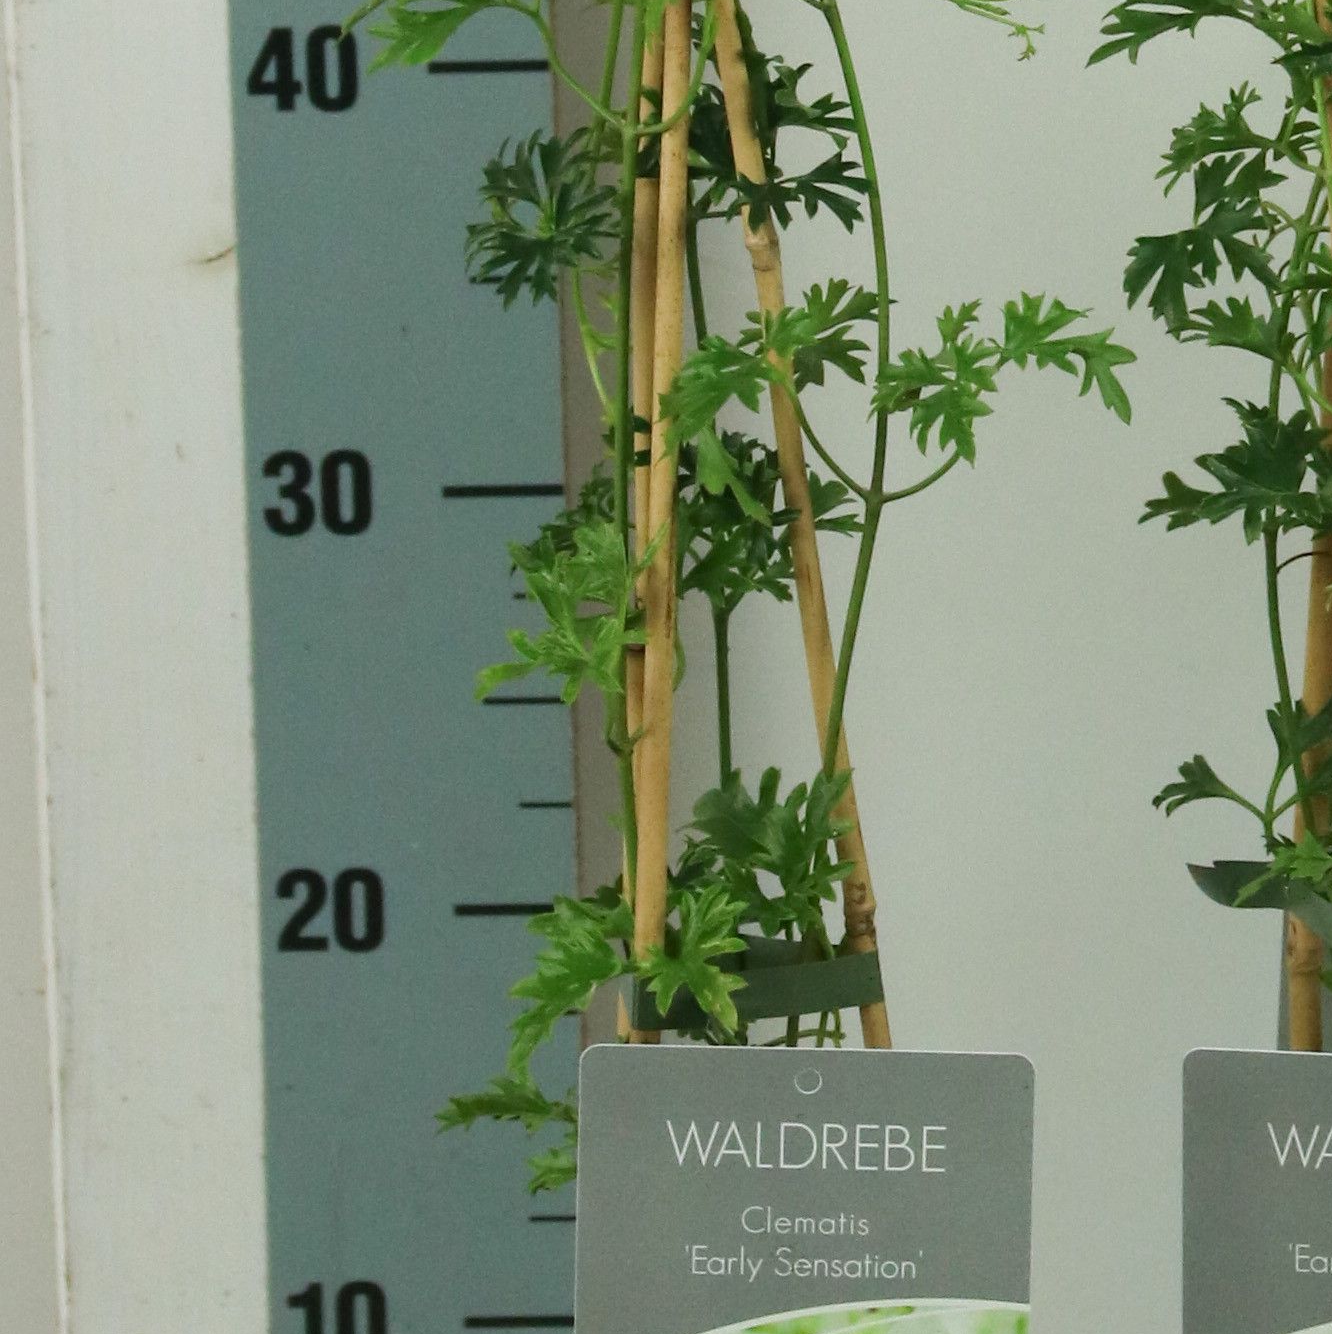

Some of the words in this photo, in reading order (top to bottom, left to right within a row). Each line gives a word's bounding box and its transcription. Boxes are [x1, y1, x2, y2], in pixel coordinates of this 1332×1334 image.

[246, 24, 360, 113] 40
[261, 448, 374, 538] 30
[274, 866, 386, 954] 20
[666, 1119, 948, 1174] WALDREBE
[741, 1205, 870, 1238] Clematis
[685, 1244, 763, 1283] 'Early
[774, 1246, 924, 1280] Sensation'
